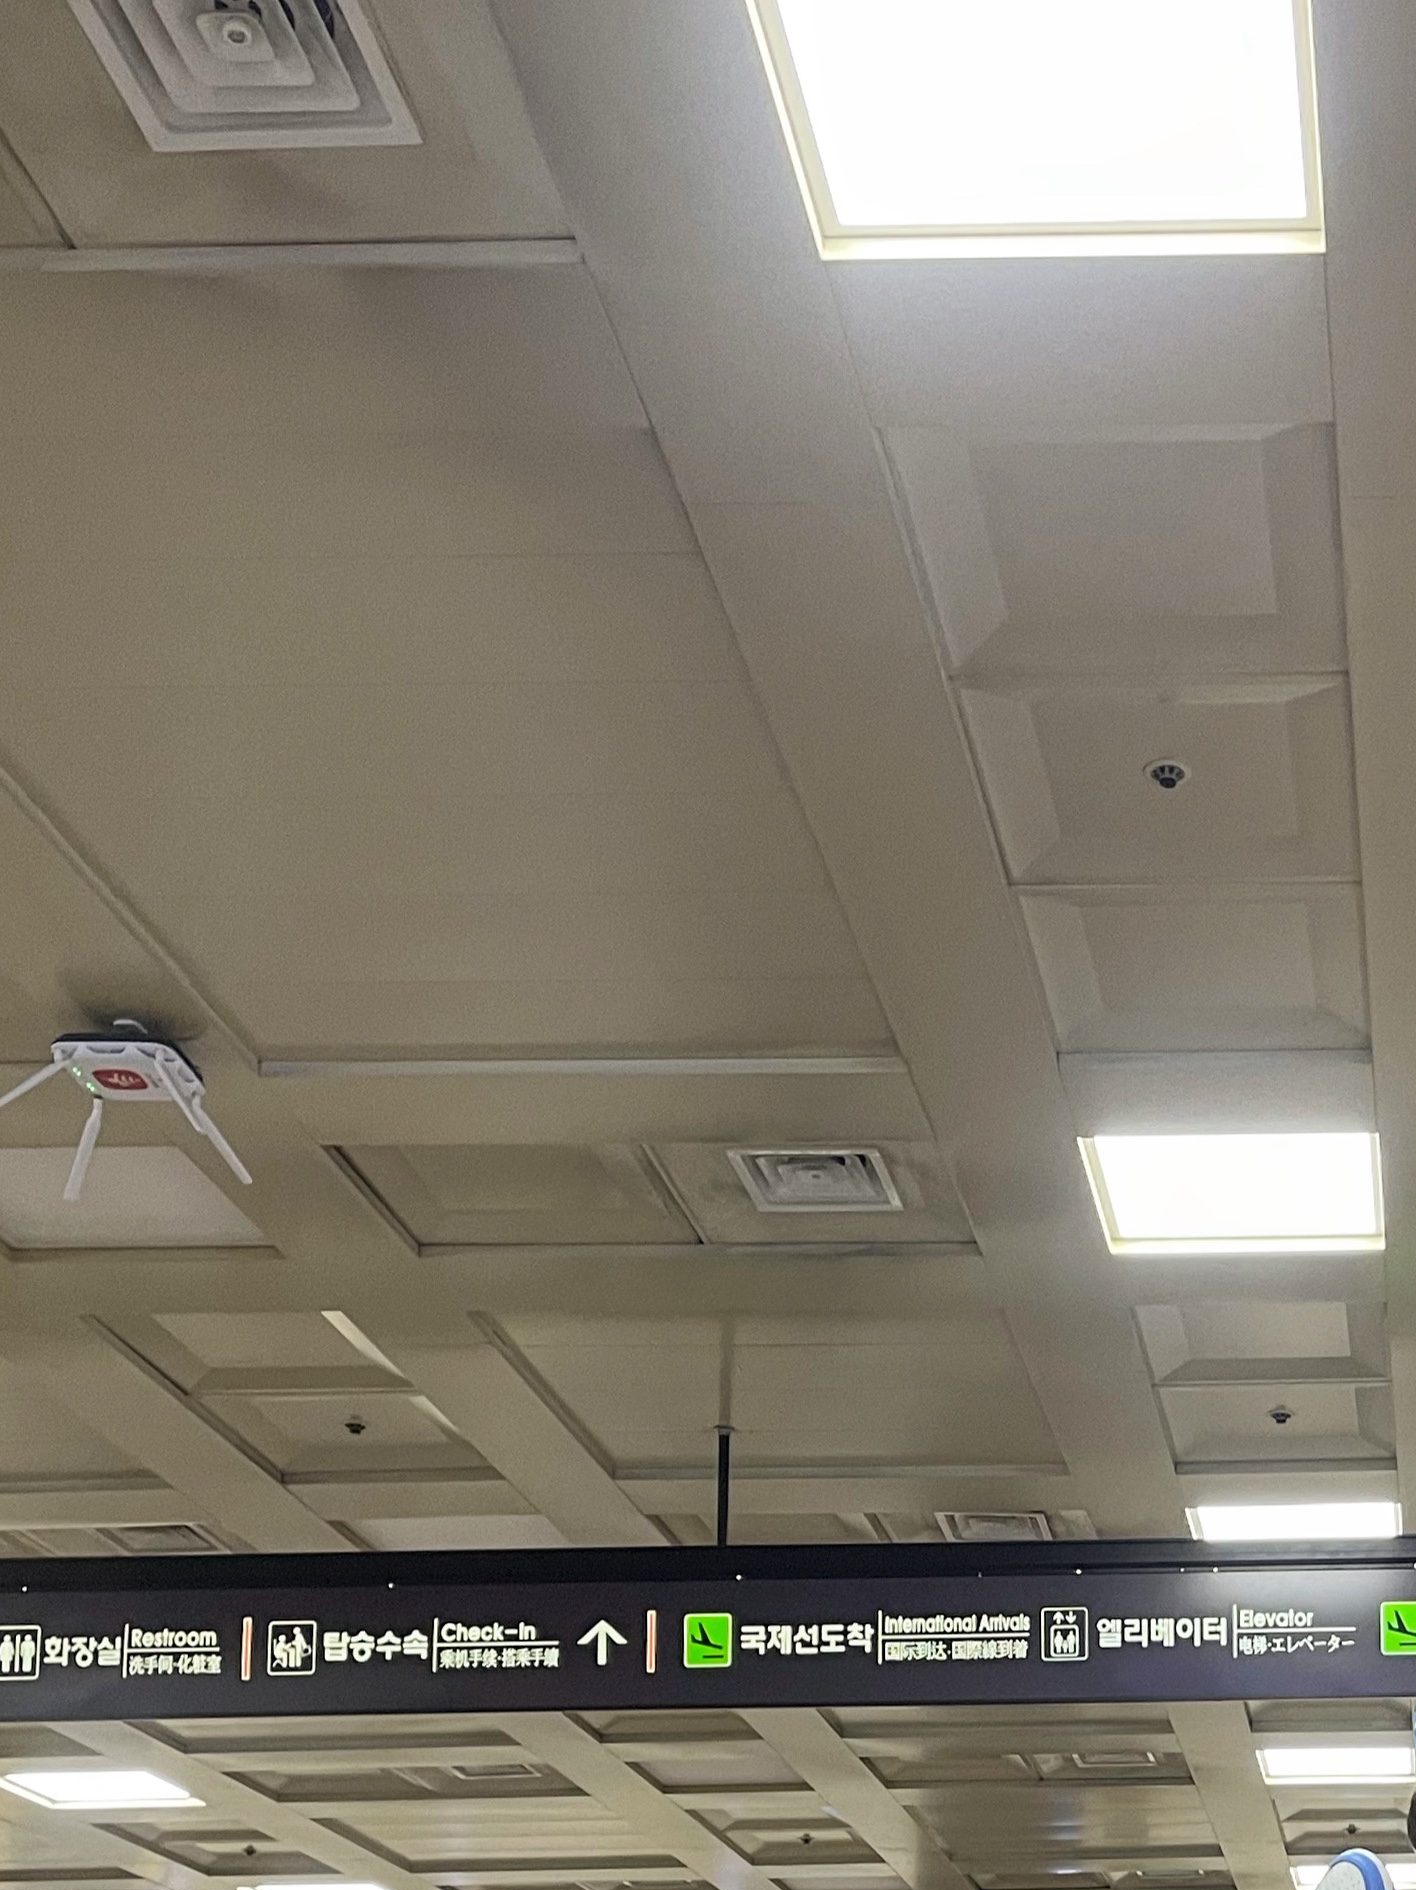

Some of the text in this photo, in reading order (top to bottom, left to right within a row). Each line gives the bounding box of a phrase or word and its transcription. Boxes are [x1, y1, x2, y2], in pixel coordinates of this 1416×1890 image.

[440, 1621, 536, 1642] Check-In
[885, 1612, 1031, 1634] International Arrivals
[1096, 1616, 1228, 1648] 엘리베이터
[1239, 1609, 1314, 1628] Elevator
[131, 1628, 217, 1648] Restroom
[323, 1629, 429, 1662] 탑승수속
[740, 1622, 874, 1655] 국제선도착
[43, 1636, 122, 1668] 화장실
